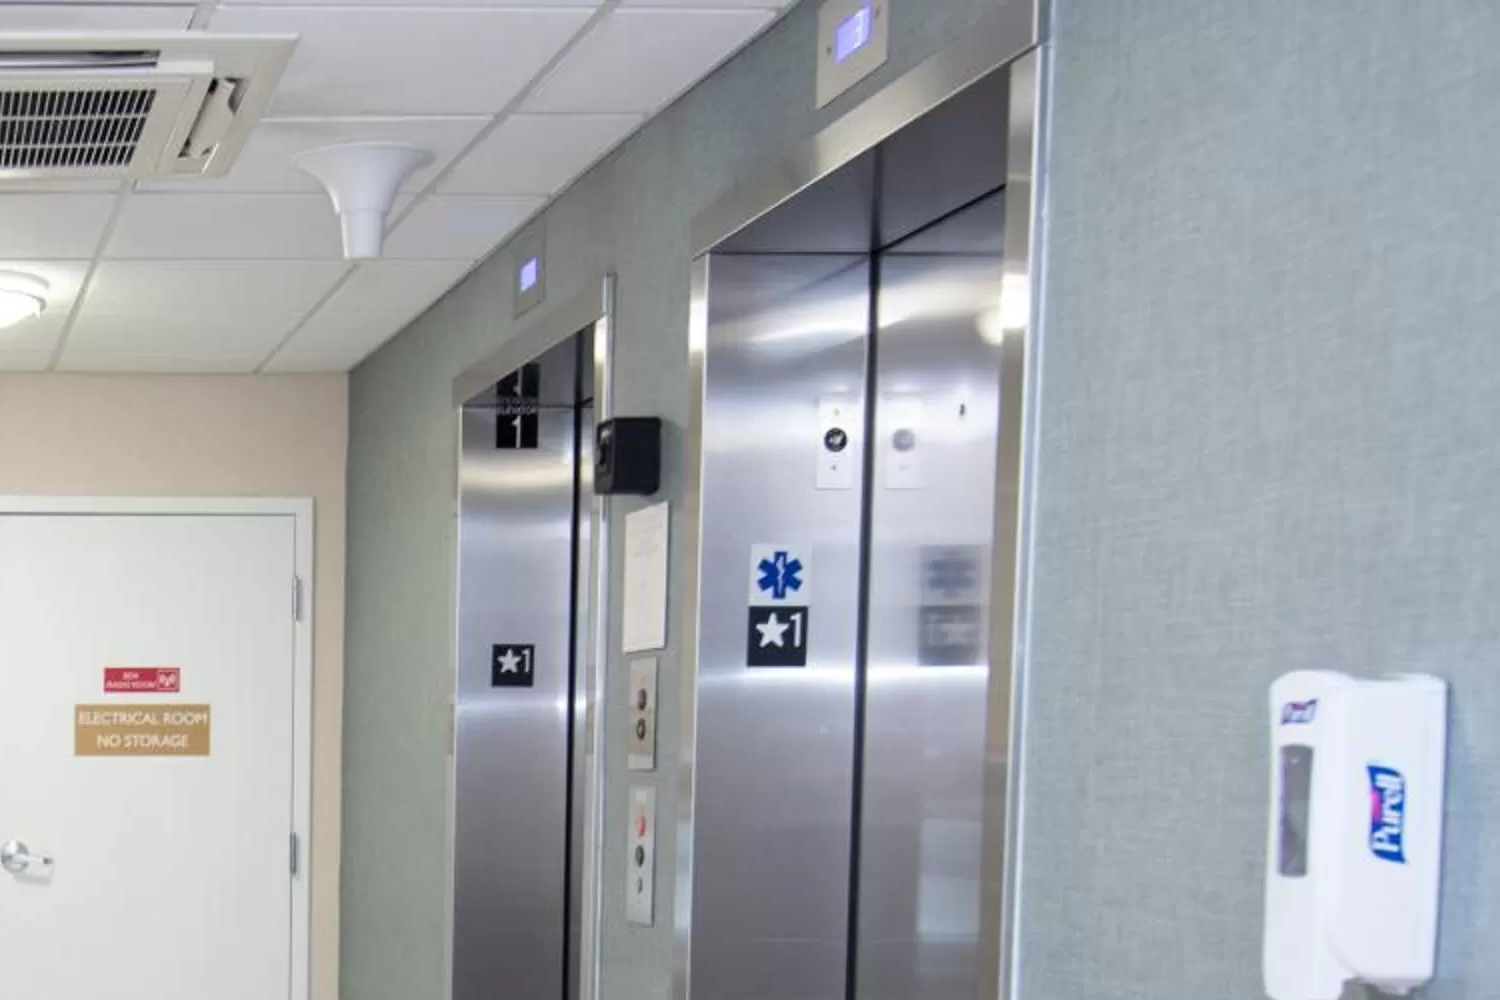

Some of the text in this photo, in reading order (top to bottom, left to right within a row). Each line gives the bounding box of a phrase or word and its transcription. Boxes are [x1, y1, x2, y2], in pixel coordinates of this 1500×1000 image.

[790, 611, 803, 648] 1
[521, 648, 530, 673] 1
[78, 711, 208, 726] ELECTRICAL ROOM
[97, 733, 189, 749] NO STORAGE
